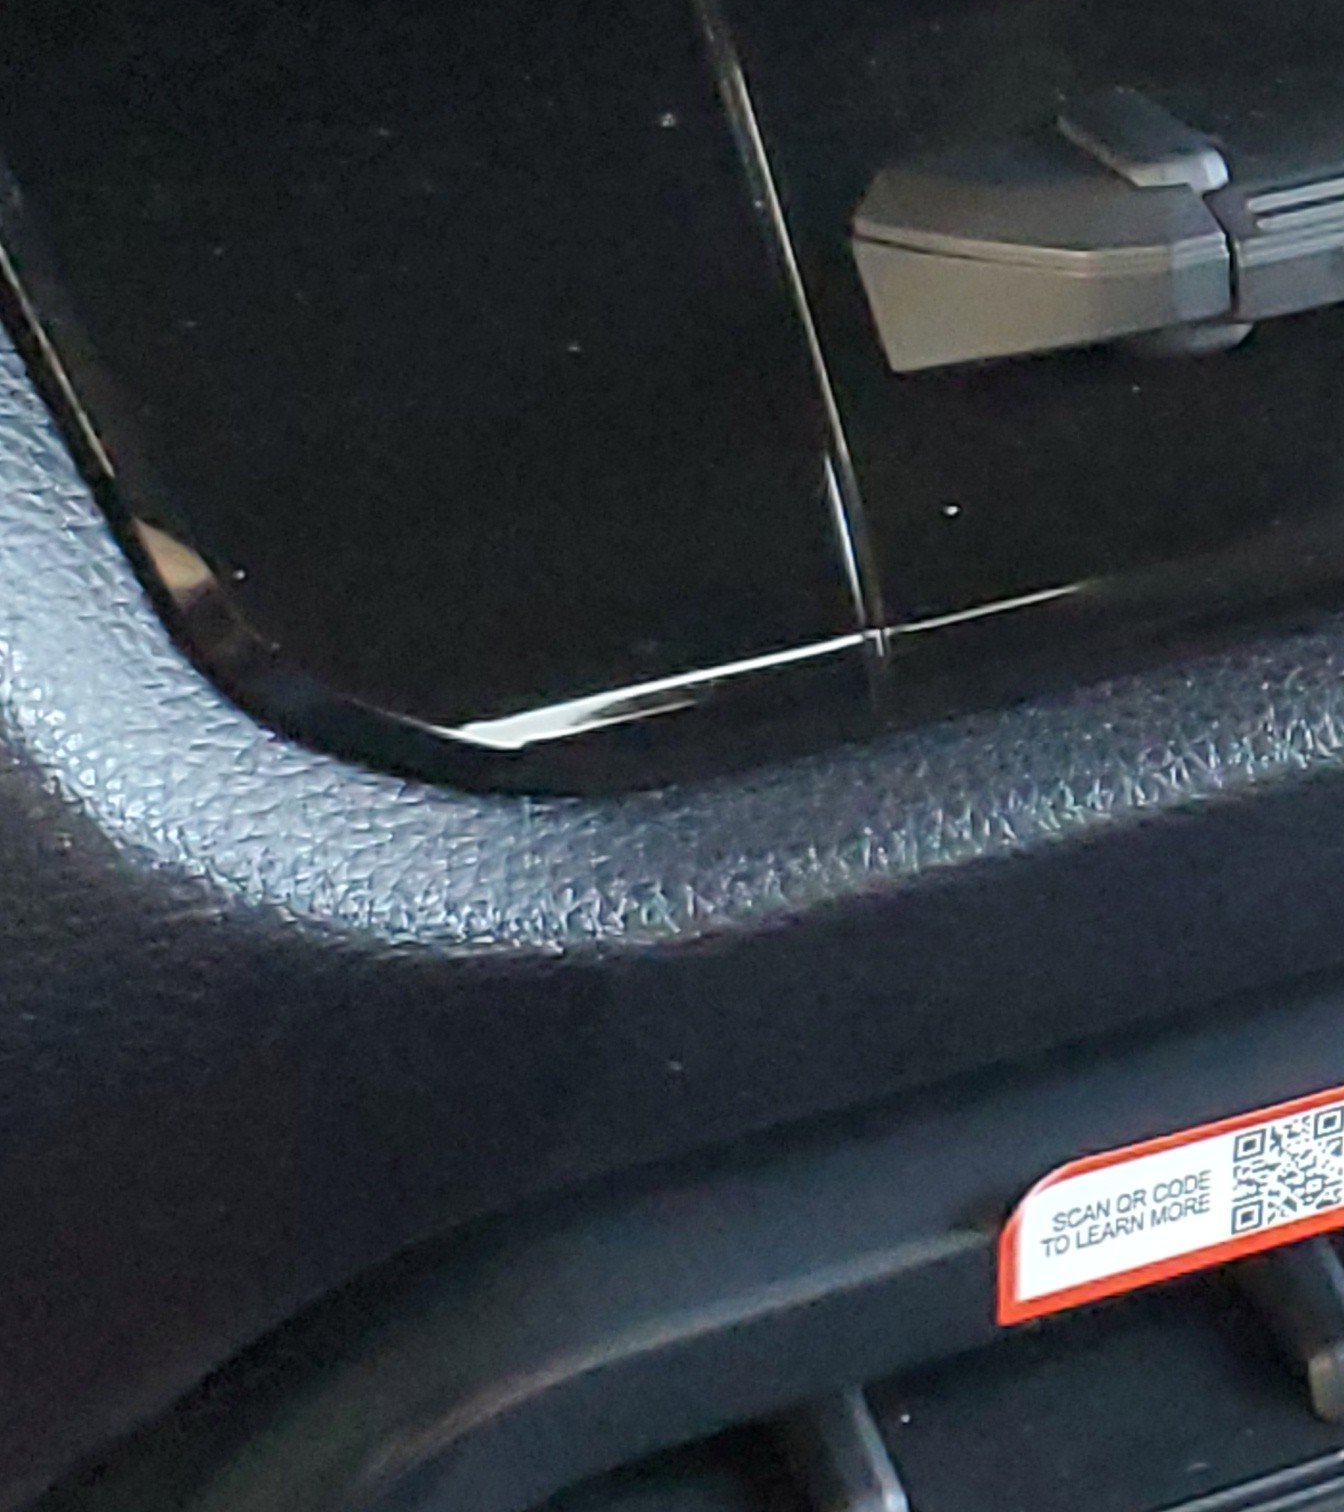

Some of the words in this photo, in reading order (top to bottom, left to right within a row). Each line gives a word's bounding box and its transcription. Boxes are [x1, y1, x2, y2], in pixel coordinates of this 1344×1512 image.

[1039, 1232, 1071, 1259] TO
[1074, 1210, 1145, 1250] LEARN
[1149, 1190, 1211, 1229] MORE
[1050, 1196, 1111, 1234] SCAN
[1114, 1186, 1148, 1215] QR
[1151, 1167, 1212, 1205] CODE
